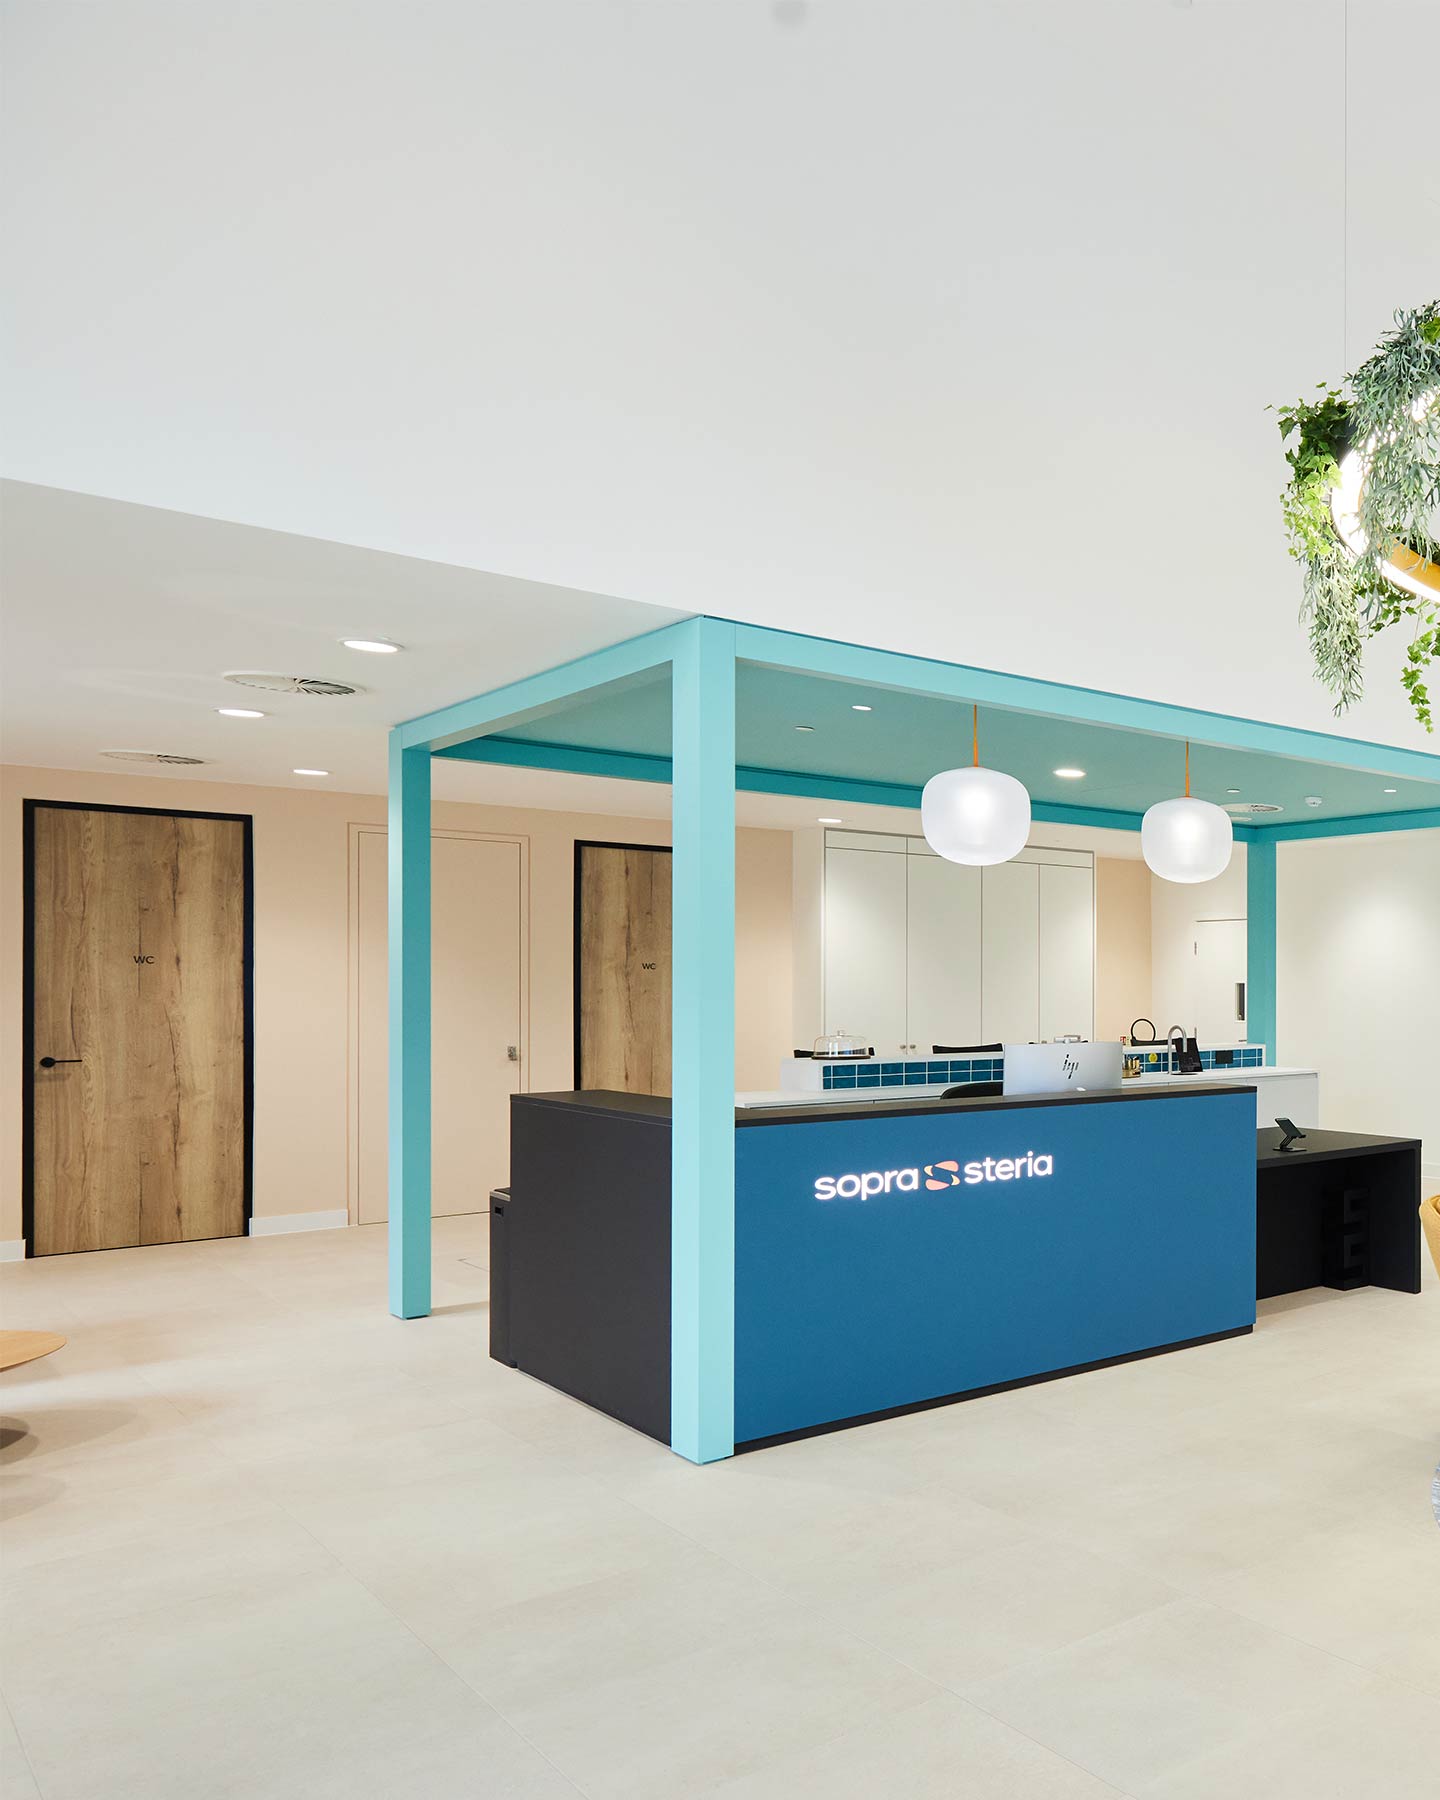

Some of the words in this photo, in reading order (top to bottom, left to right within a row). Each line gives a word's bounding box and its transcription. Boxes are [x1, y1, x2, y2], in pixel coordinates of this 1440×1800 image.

[133, 955, 155, 965] WC
[641, 962, 657, 970] WC
[814, 1167, 919, 1201] sopra
[963, 1150, 1053, 1184] steria
